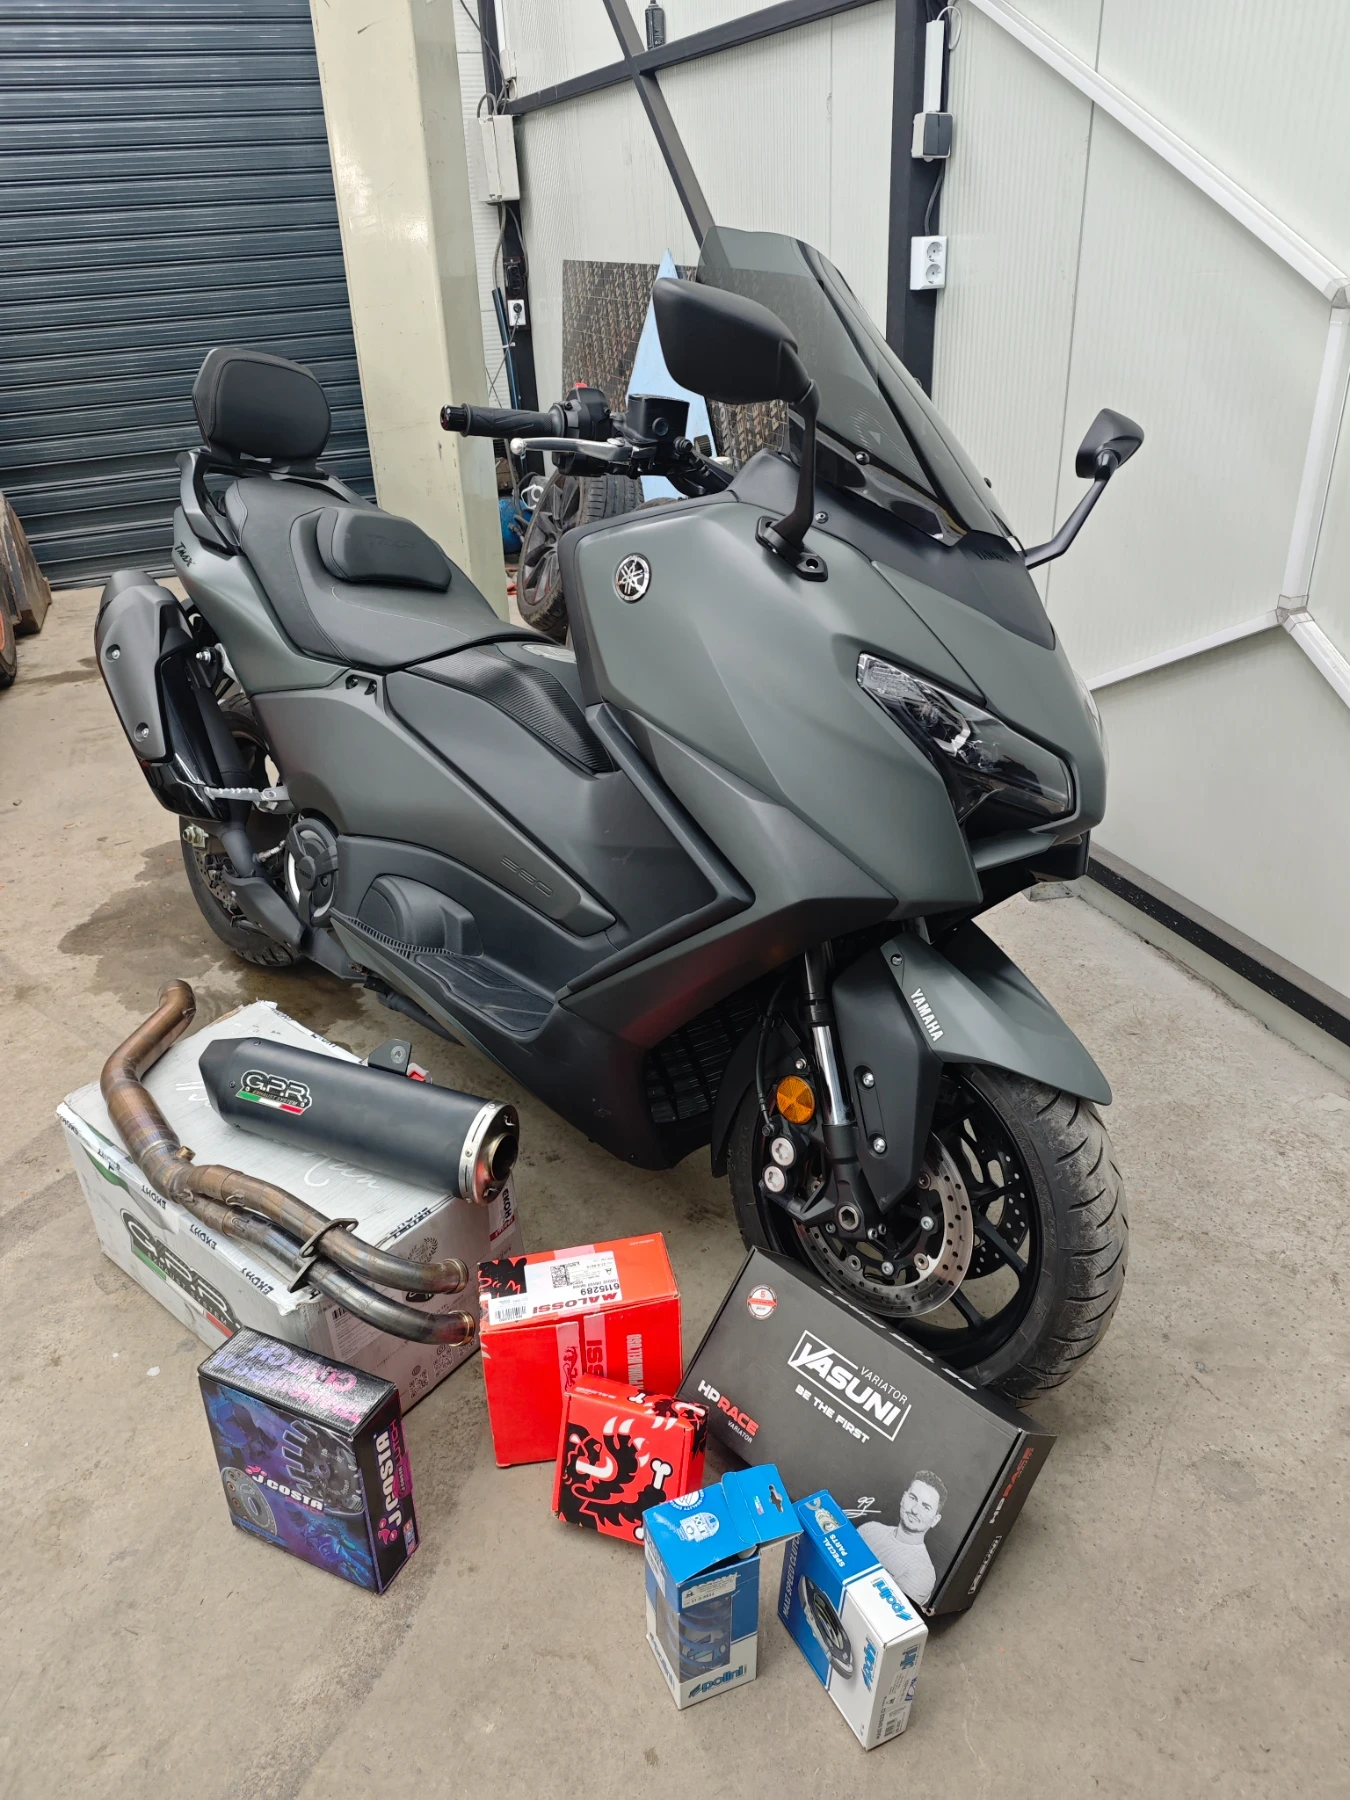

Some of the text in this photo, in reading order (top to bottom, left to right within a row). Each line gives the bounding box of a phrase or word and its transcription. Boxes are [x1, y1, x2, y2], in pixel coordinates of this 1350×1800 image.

[910, 987, 944, 1041] YAMAHA
[252, 1089, 299, 1106] EXHAUST SYSTEM
[532, 1292, 618, 1314] MALOSSI
[580, 1283, 620, 1296] 6115289
[249, 1345, 358, 1393] CLUTCH
[787, 1342, 901, 1427] YASUNI
[861, 1366, 908, 1405] VARIATOR
[795, 1384, 870, 1443] BE THE FIRST
[727, 1420, 753, 1444] VARIATOR
[252, 1474, 324, 1511] J.COSTA
[376, 1430, 402, 1527] J.COSTA
[823, 1536, 845, 1568] SPECIAL
[829, 1533, 848, 1557] PARTS
[785, 1566, 796, 1596] SPEED
[873, 1578, 906, 1615] polini
[782, 1593, 792, 1619] MAXI
[701, 1664, 745, 1693] polini
[862, 1640, 878, 1683] polini
